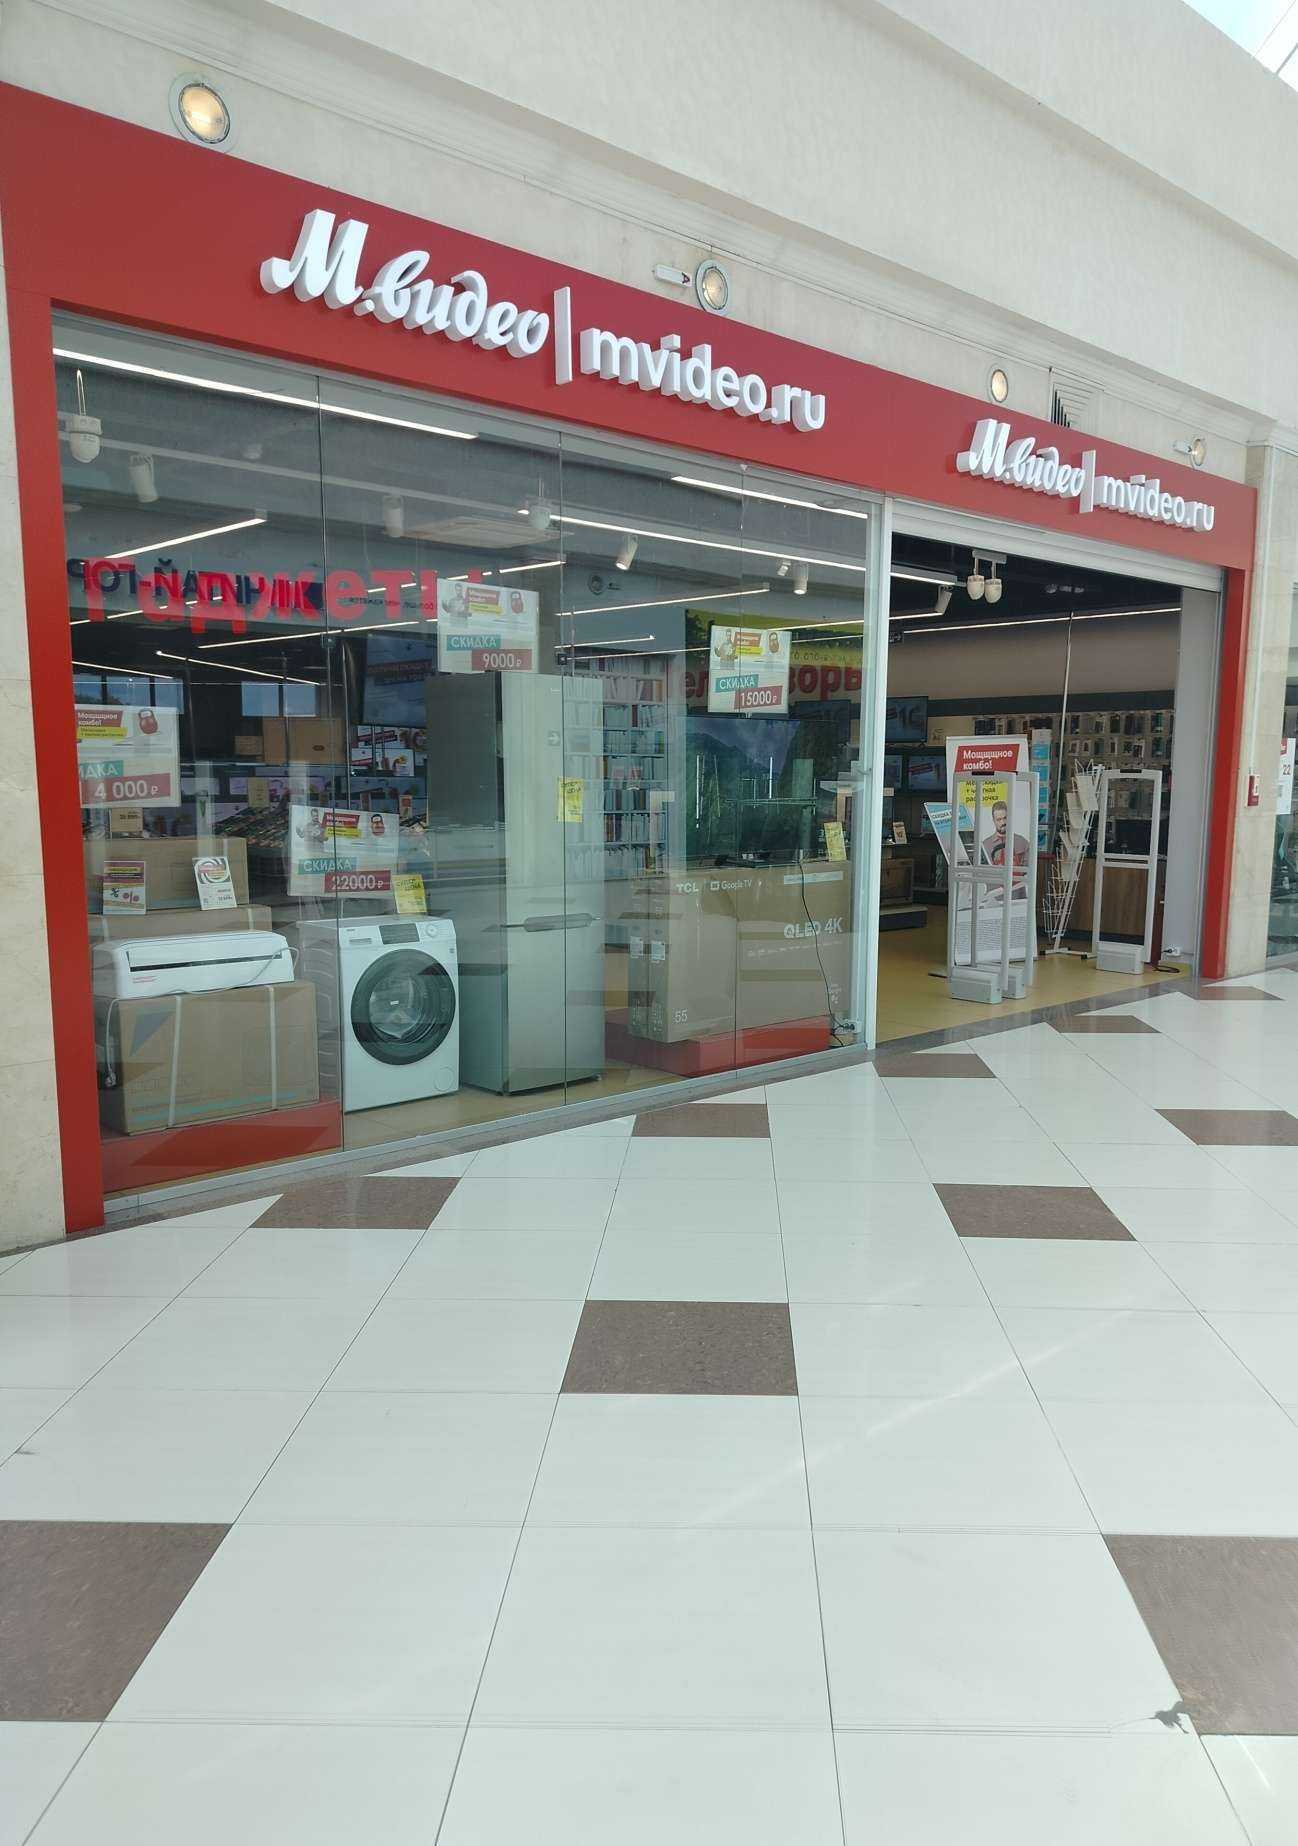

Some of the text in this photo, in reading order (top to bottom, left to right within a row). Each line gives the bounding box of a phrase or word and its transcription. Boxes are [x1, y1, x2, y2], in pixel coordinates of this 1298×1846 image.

[580, 328, 826, 432] mvideo.ru
[1095, 475, 1215, 533] mvideo.ru
[451, 635, 497, 649] СКИДКА
[719, 675, 755, 690] СКИДКА
[963, 749, 1013, 760] Мощщщное
[963, 760, 993, 771] комбо!
[303, 860, 352, 872] СКИДКА
[676, 883, 699, 893] TCL
[784, 917, 843, 938] QLED 4K
